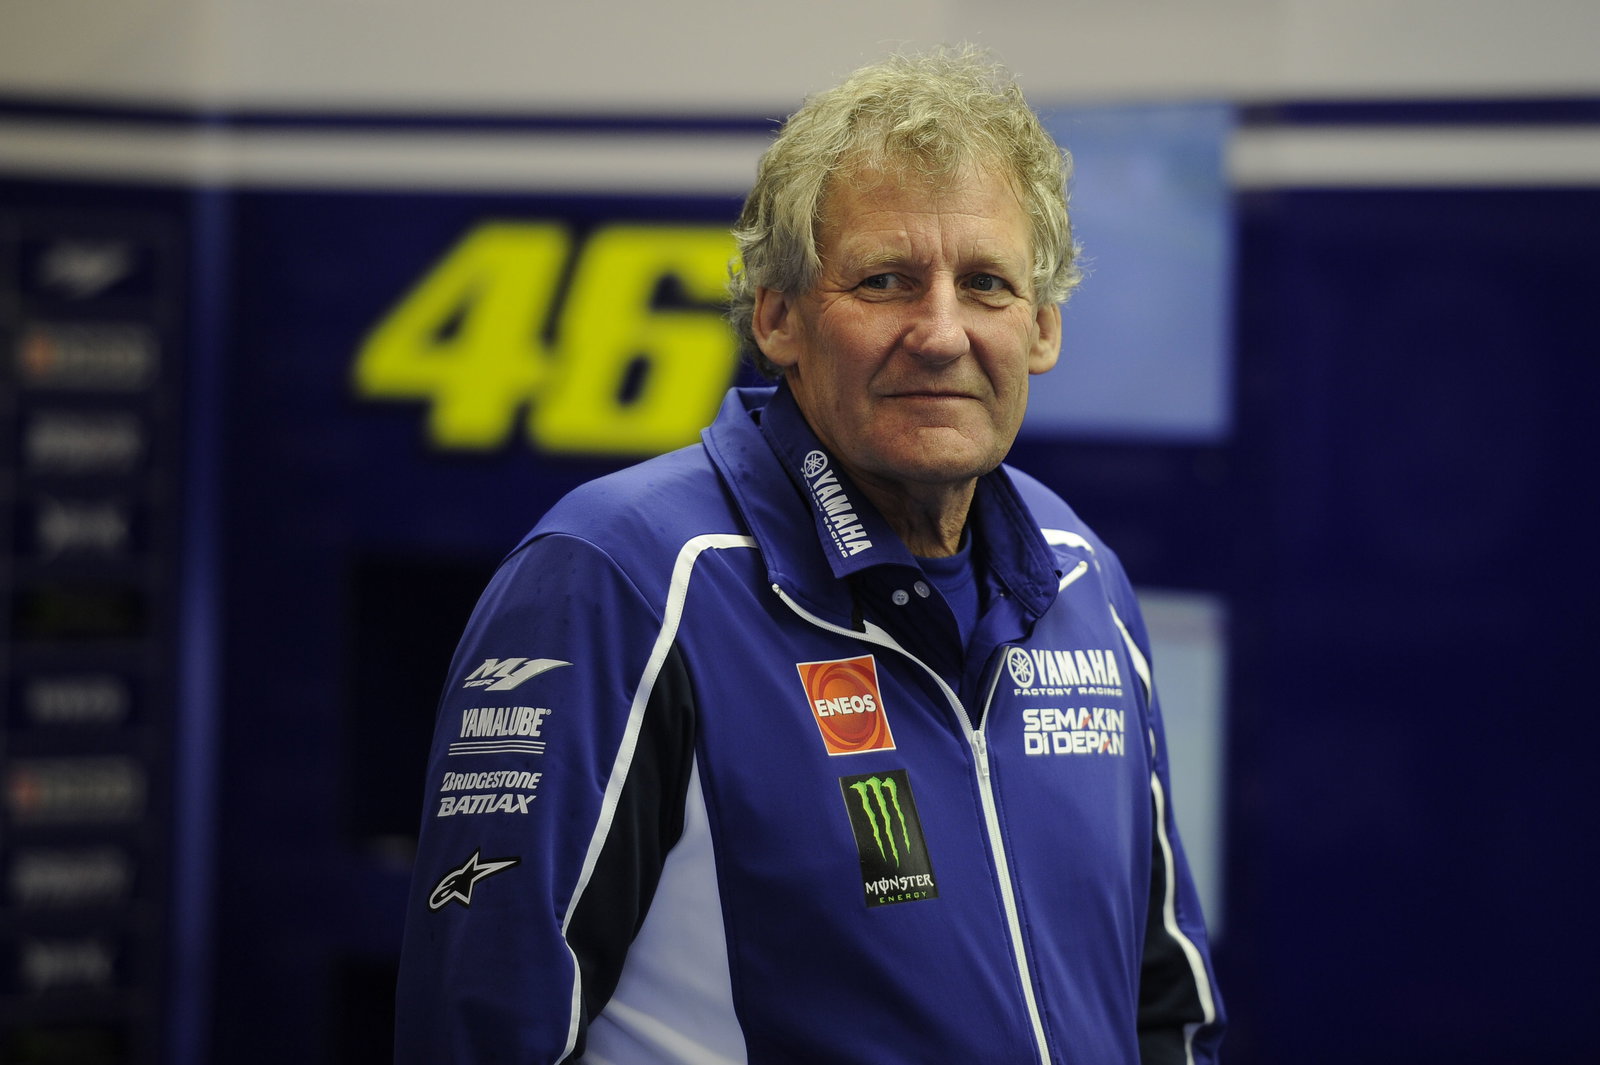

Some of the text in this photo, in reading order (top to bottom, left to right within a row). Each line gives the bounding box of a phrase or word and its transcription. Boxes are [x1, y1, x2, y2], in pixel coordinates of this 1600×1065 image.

[354, 221, 741, 453] 46
[812, 469, 873, 556] YAMAHA
[823, 516, 849, 559] RACING
[1030, 649, 1122, 686] YAMAHA
[1013, 686, 1124, 697] FACTORY RACING
[814, 694, 877, 718] ENEOS
[1022, 706, 1125, 733] SEMAKIN
[1051, 730, 1125, 757] DEPAN
[440, 770, 543, 792] BRIDGESTONE
[437, 793, 537, 817] BATTLAX
[865, 873, 934, 896] MONSTER
[879, 891, 928, 904] ENERGY
